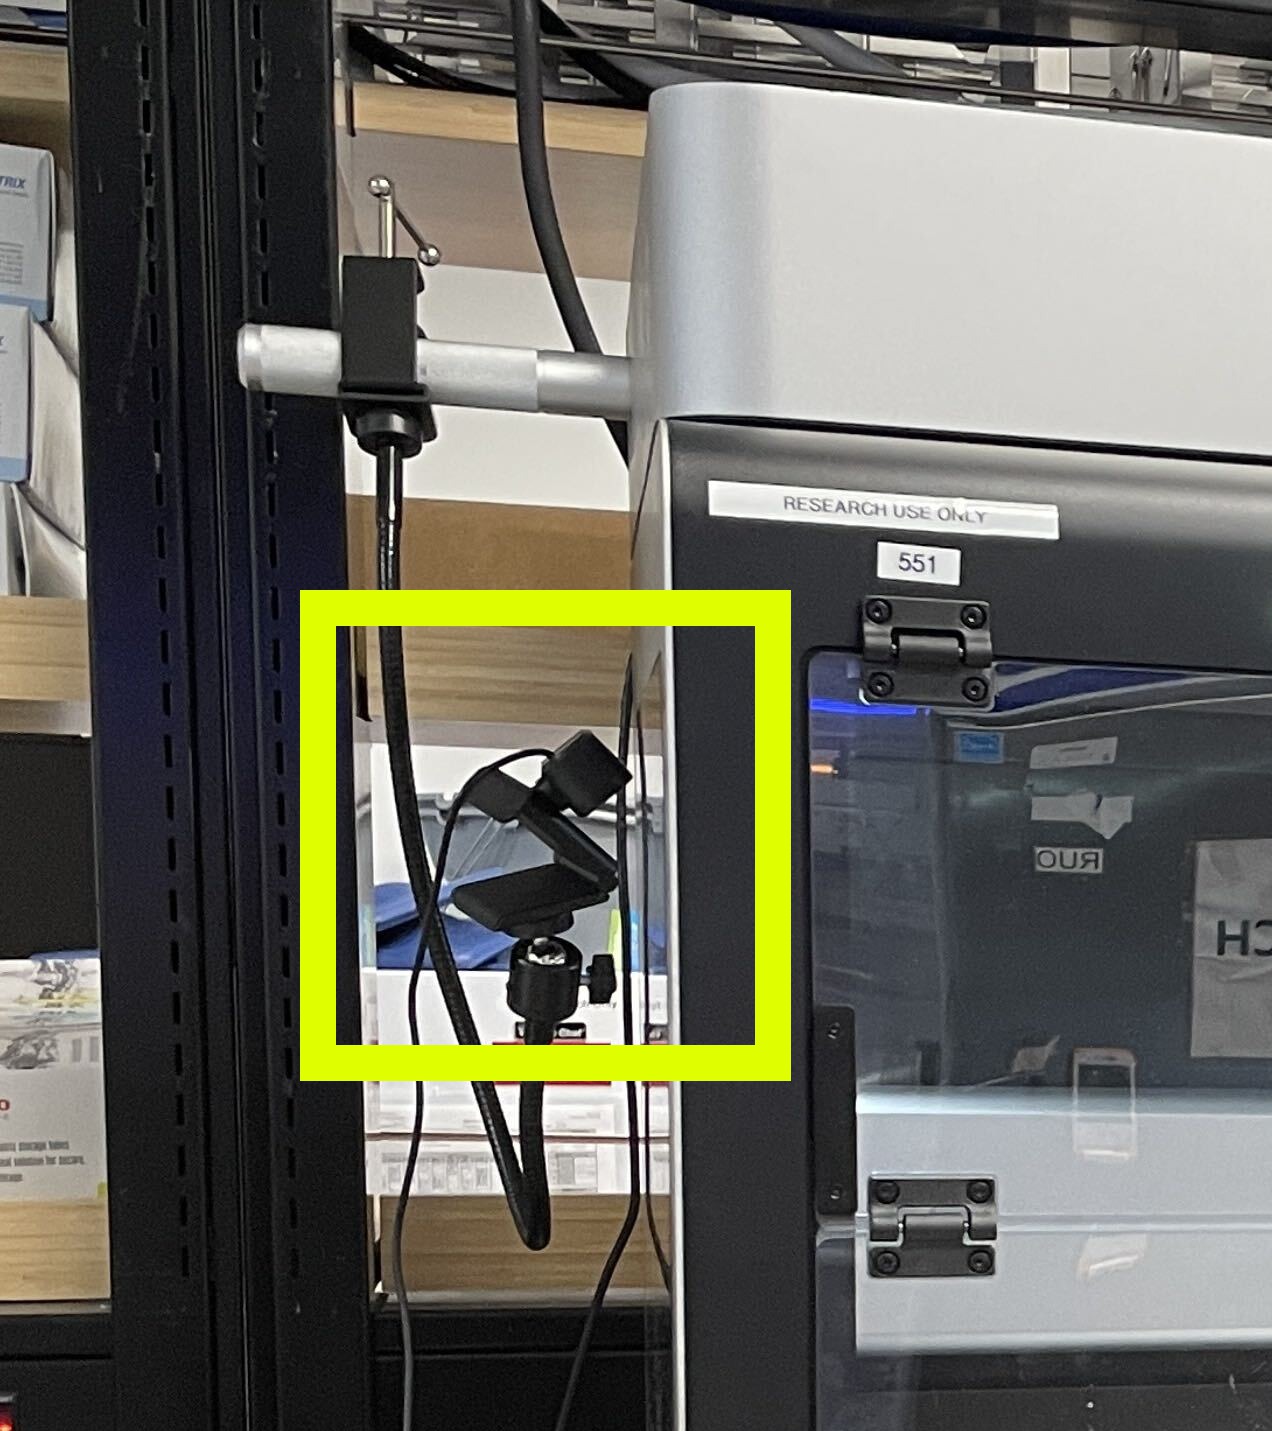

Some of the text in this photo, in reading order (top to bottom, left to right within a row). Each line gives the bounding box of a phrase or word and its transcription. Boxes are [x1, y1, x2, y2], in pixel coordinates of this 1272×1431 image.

[783, 496, 987, 525] RESEARCH USE ONLY
[898, 551, 936, 575] 551
